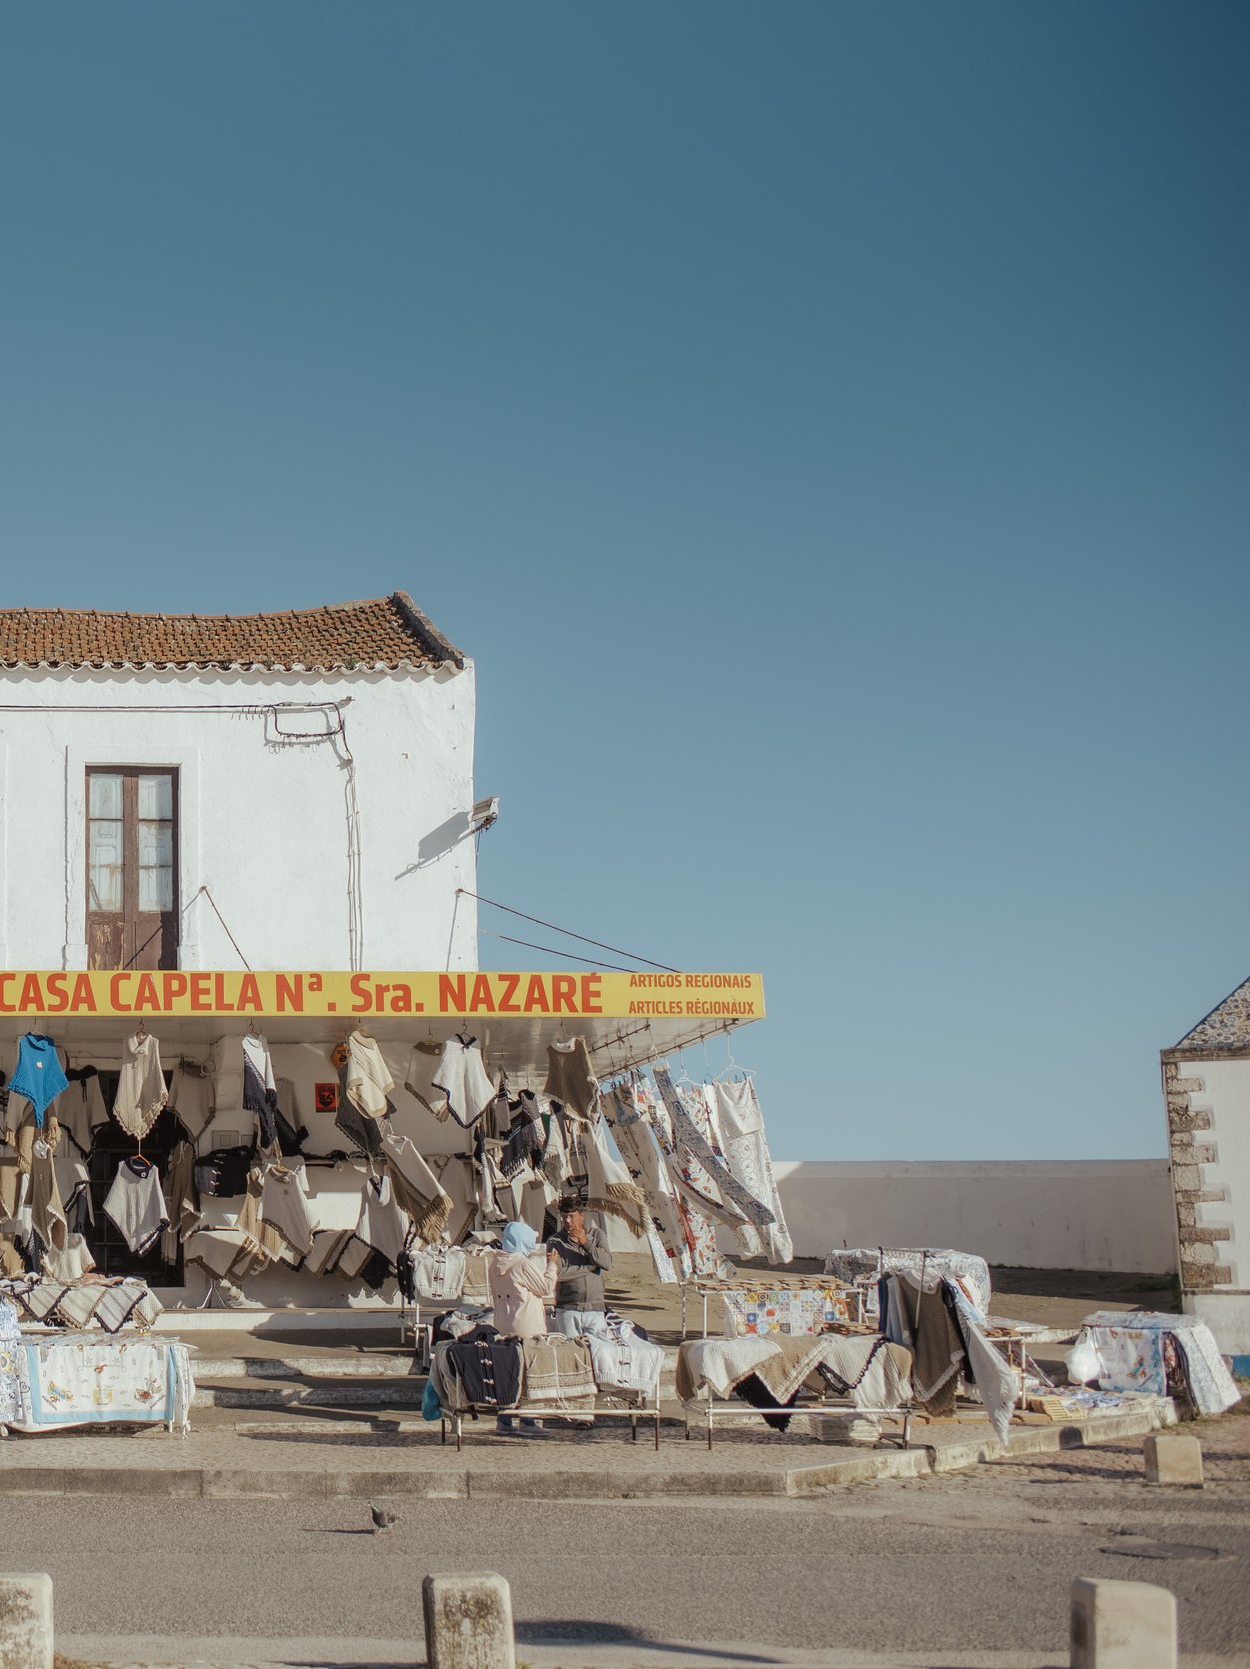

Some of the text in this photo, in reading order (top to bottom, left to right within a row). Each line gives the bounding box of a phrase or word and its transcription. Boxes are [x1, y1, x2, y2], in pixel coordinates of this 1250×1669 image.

[629, 974, 752, 989] ARTIGOS REGIONAIS
[109, 973, 262, 1012] CAPELA
[350, 973, 424, 1013] Sra.
[439, 972, 603, 1013] NAZARÉ
[628, 1000, 683, 1015] ARTICLES
